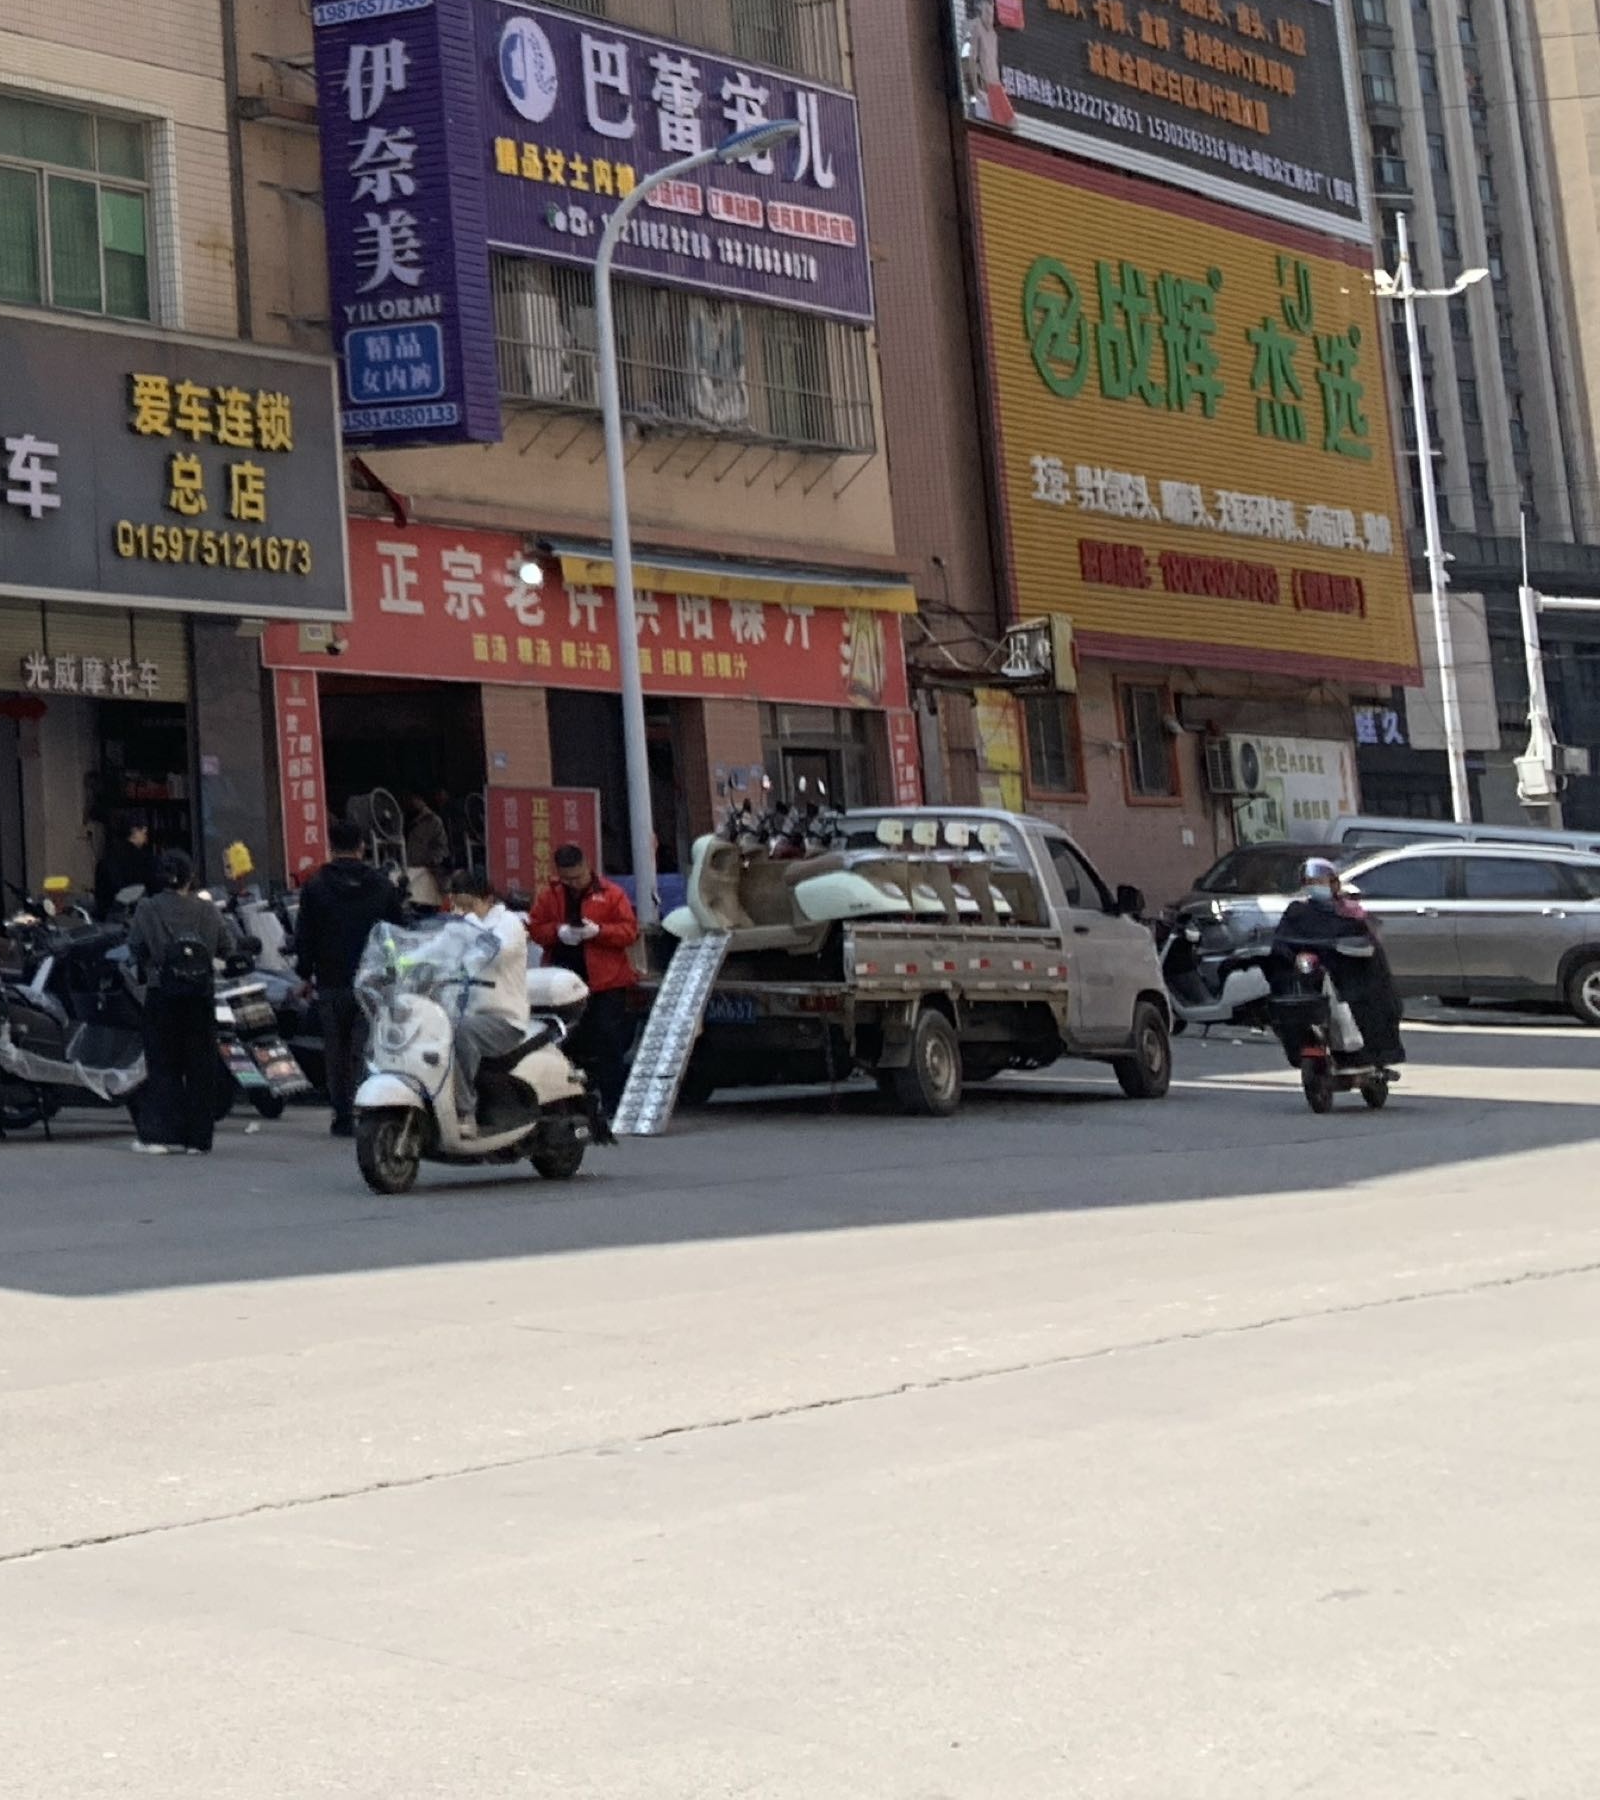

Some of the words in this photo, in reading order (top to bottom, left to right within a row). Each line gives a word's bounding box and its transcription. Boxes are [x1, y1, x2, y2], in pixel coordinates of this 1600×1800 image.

[343, 35, 423, 296] 伊奈美
[364, 333, 422, 363] 精品
[352, 363, 433, 400] 女内裤
[130, 373, 294, 454] 爱车连锁
[168, 452, 268, 524] 总店
[135, 523, 313, 576] 15975121673
[23, 650, 162, 698] 光威摩托车
